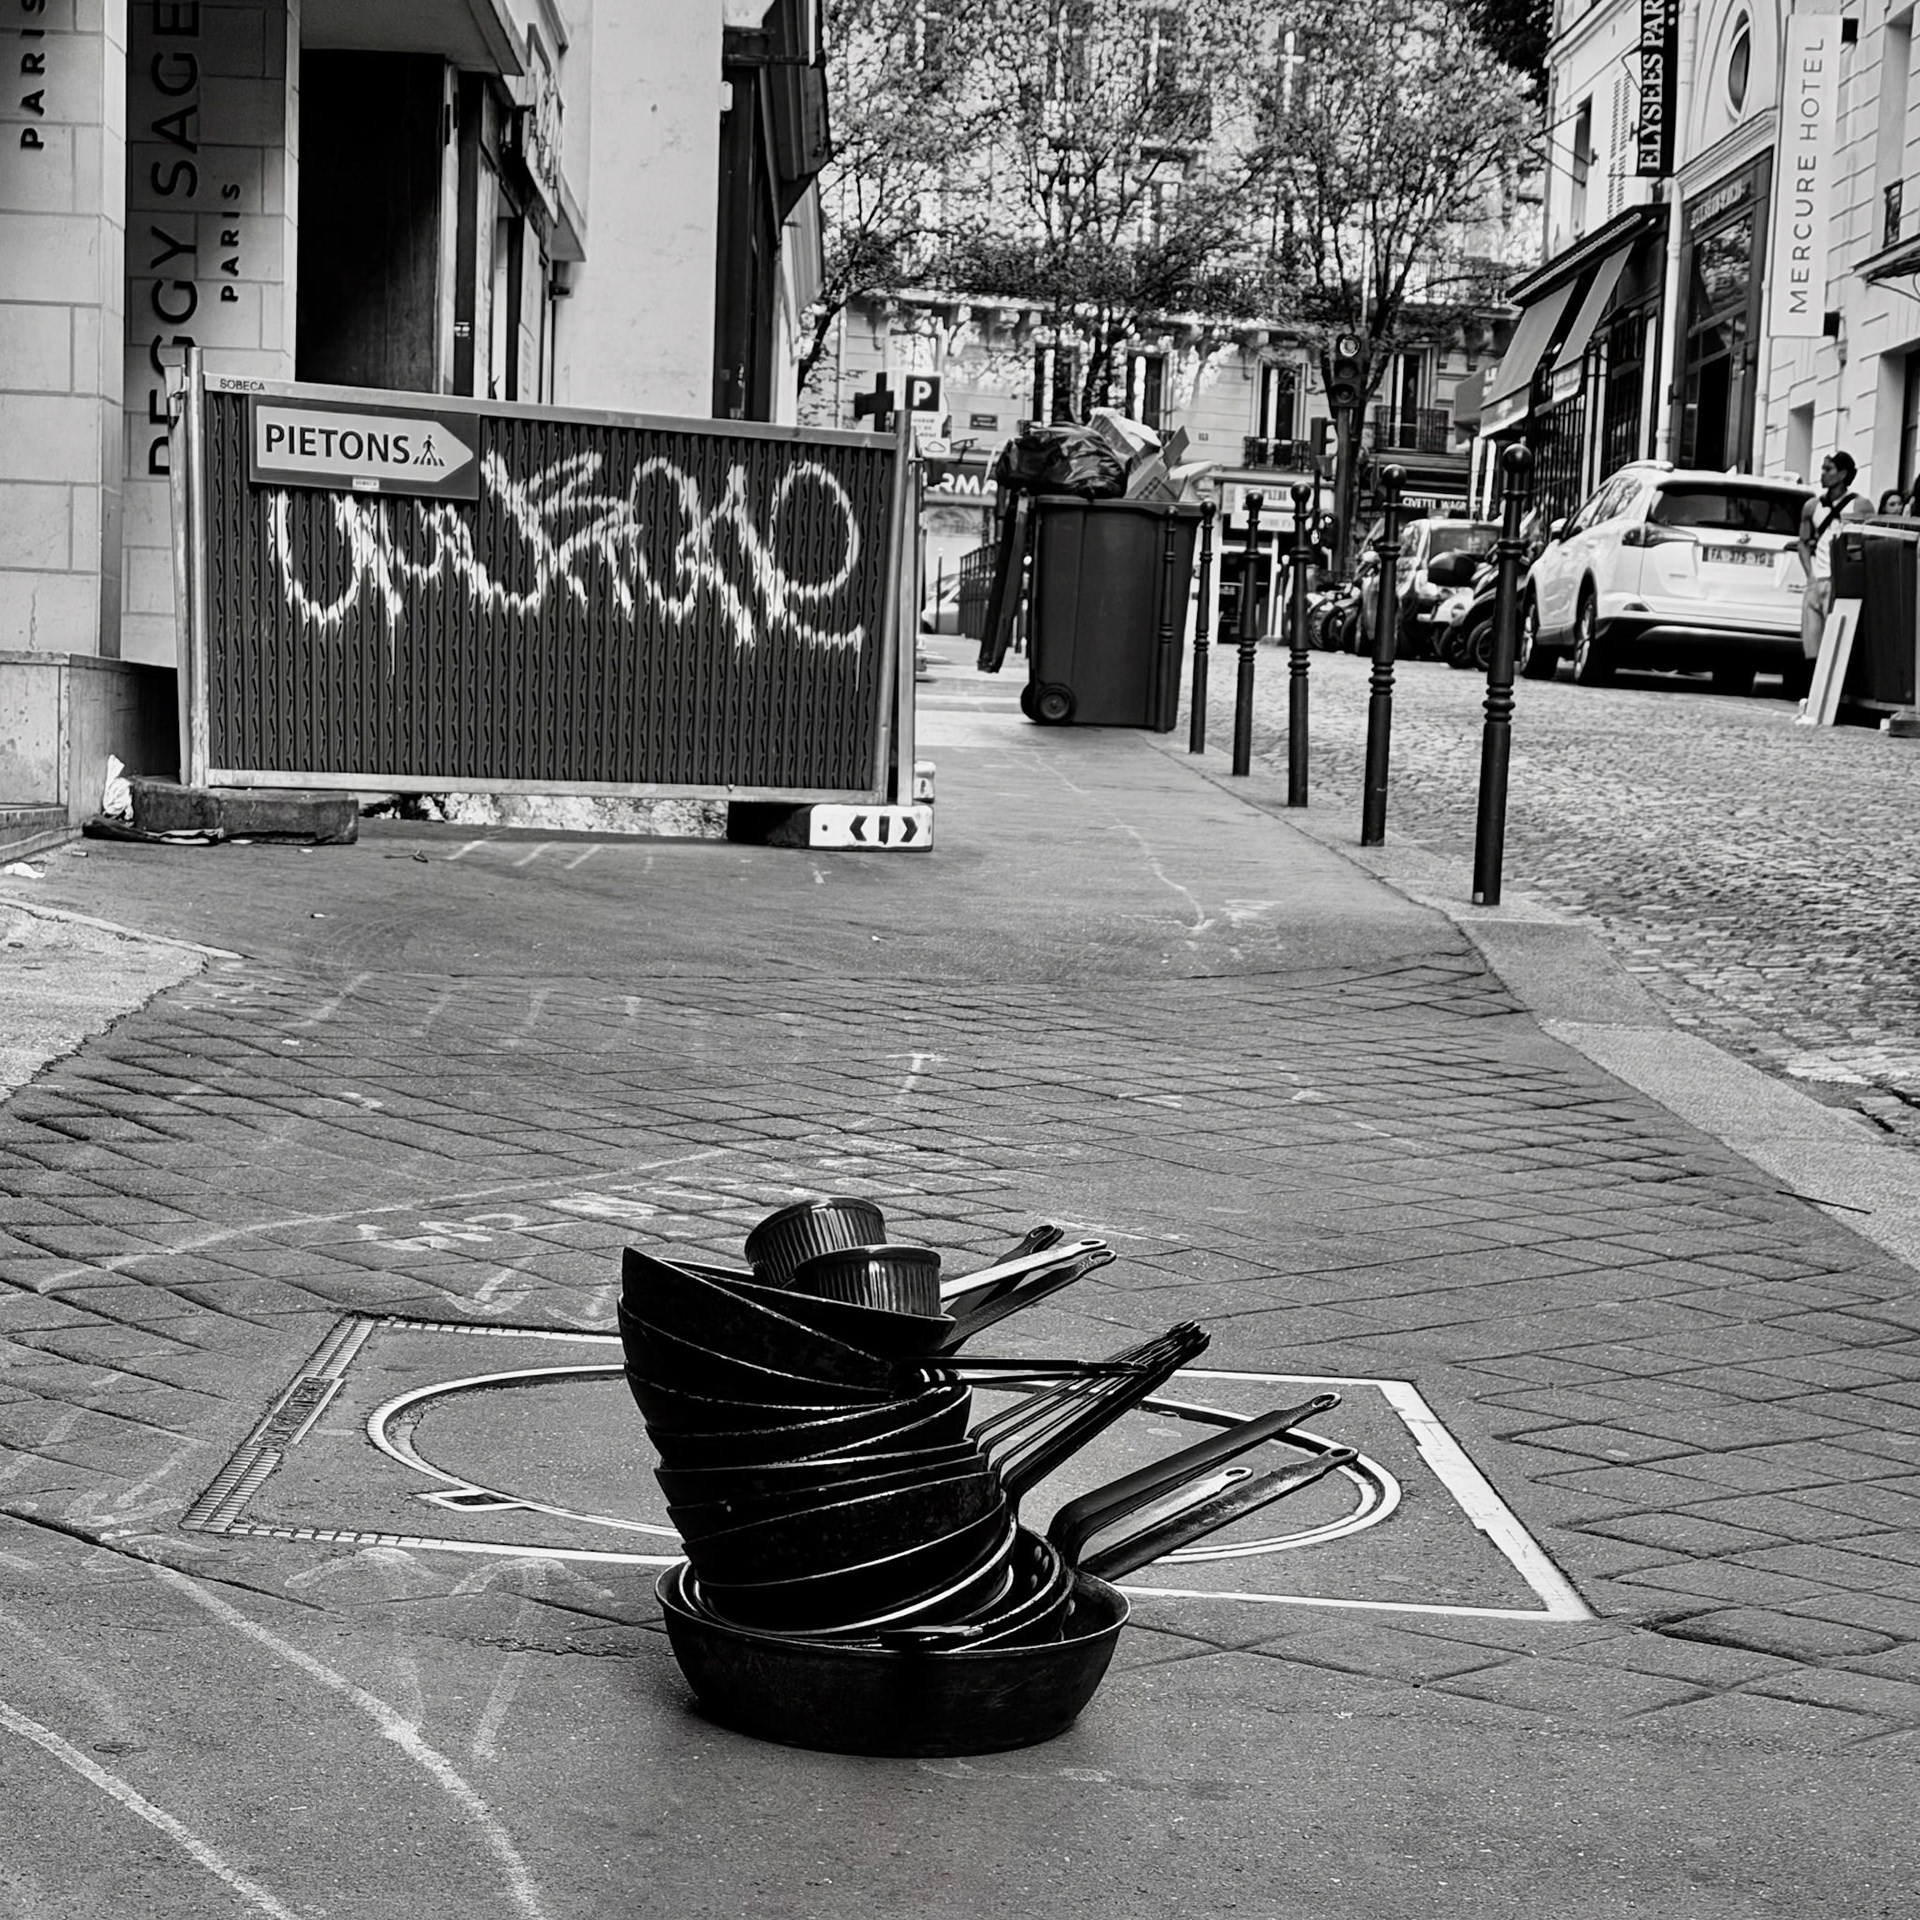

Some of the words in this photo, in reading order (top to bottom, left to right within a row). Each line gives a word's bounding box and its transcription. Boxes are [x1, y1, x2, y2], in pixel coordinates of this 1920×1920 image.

[20, 0, 46, 151] PARIS
[150, 0, 199, 198] SAGE
[1639, 53, 1664, 170] ELYSEES
[1800, 38, 1825, 141] HOTEL
[220, 184, 241, 302] PARIS
[1788, 155, 1817, 314] MERCURE
[219, 378, 265, 392] SOBECA
[912, 380, 932, 408] P
[265, 423, 411, 465] PIETONS
